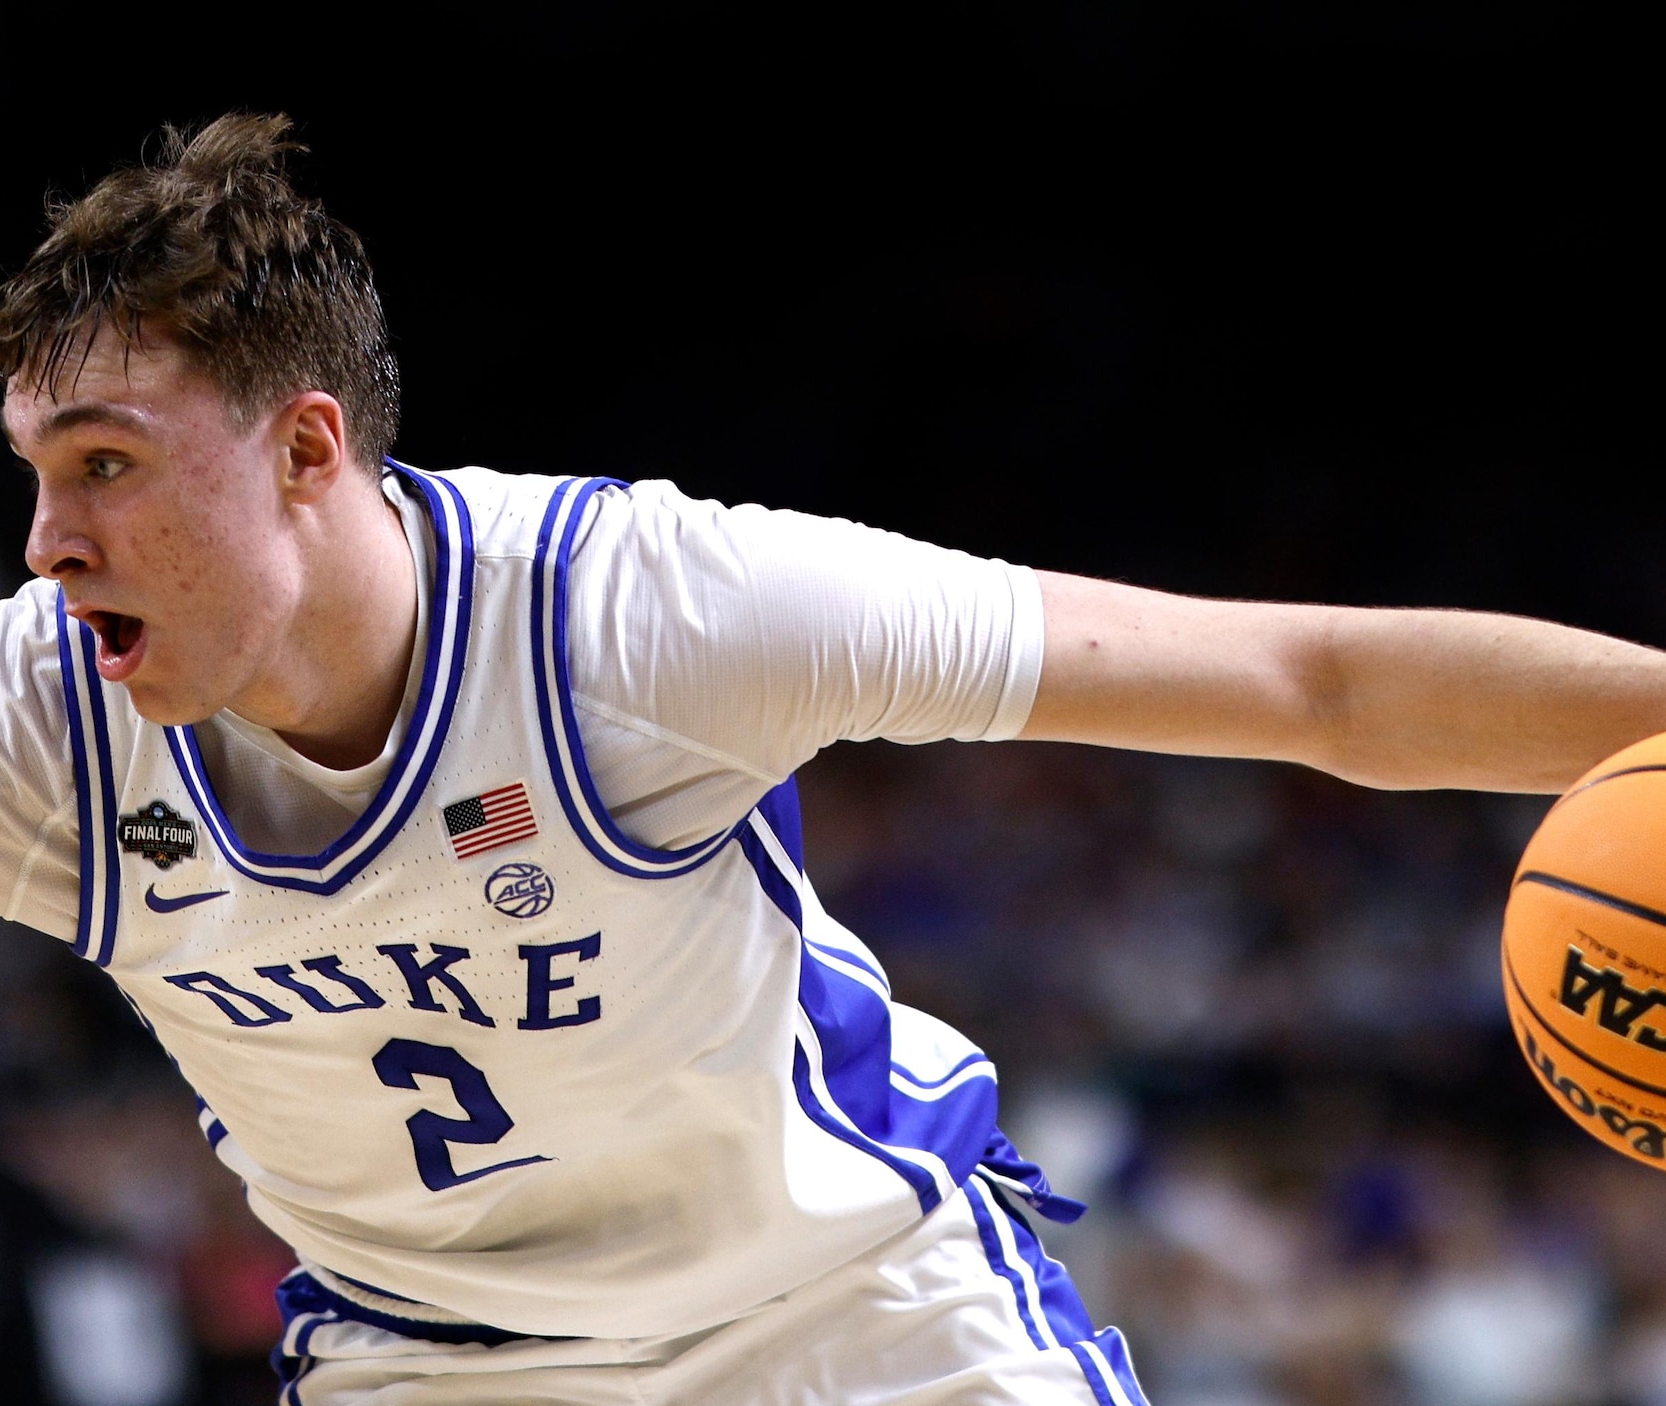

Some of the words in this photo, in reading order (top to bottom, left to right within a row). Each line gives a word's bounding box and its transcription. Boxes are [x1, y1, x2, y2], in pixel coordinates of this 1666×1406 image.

[123, 825, 161, 841] FINAL
[162, 826, 193, 845] FOUR
[496, 872, 546, 901] ACC
[162, 931, 602, 1031] DUKE
[372, 1038, 559, 1192] 2
